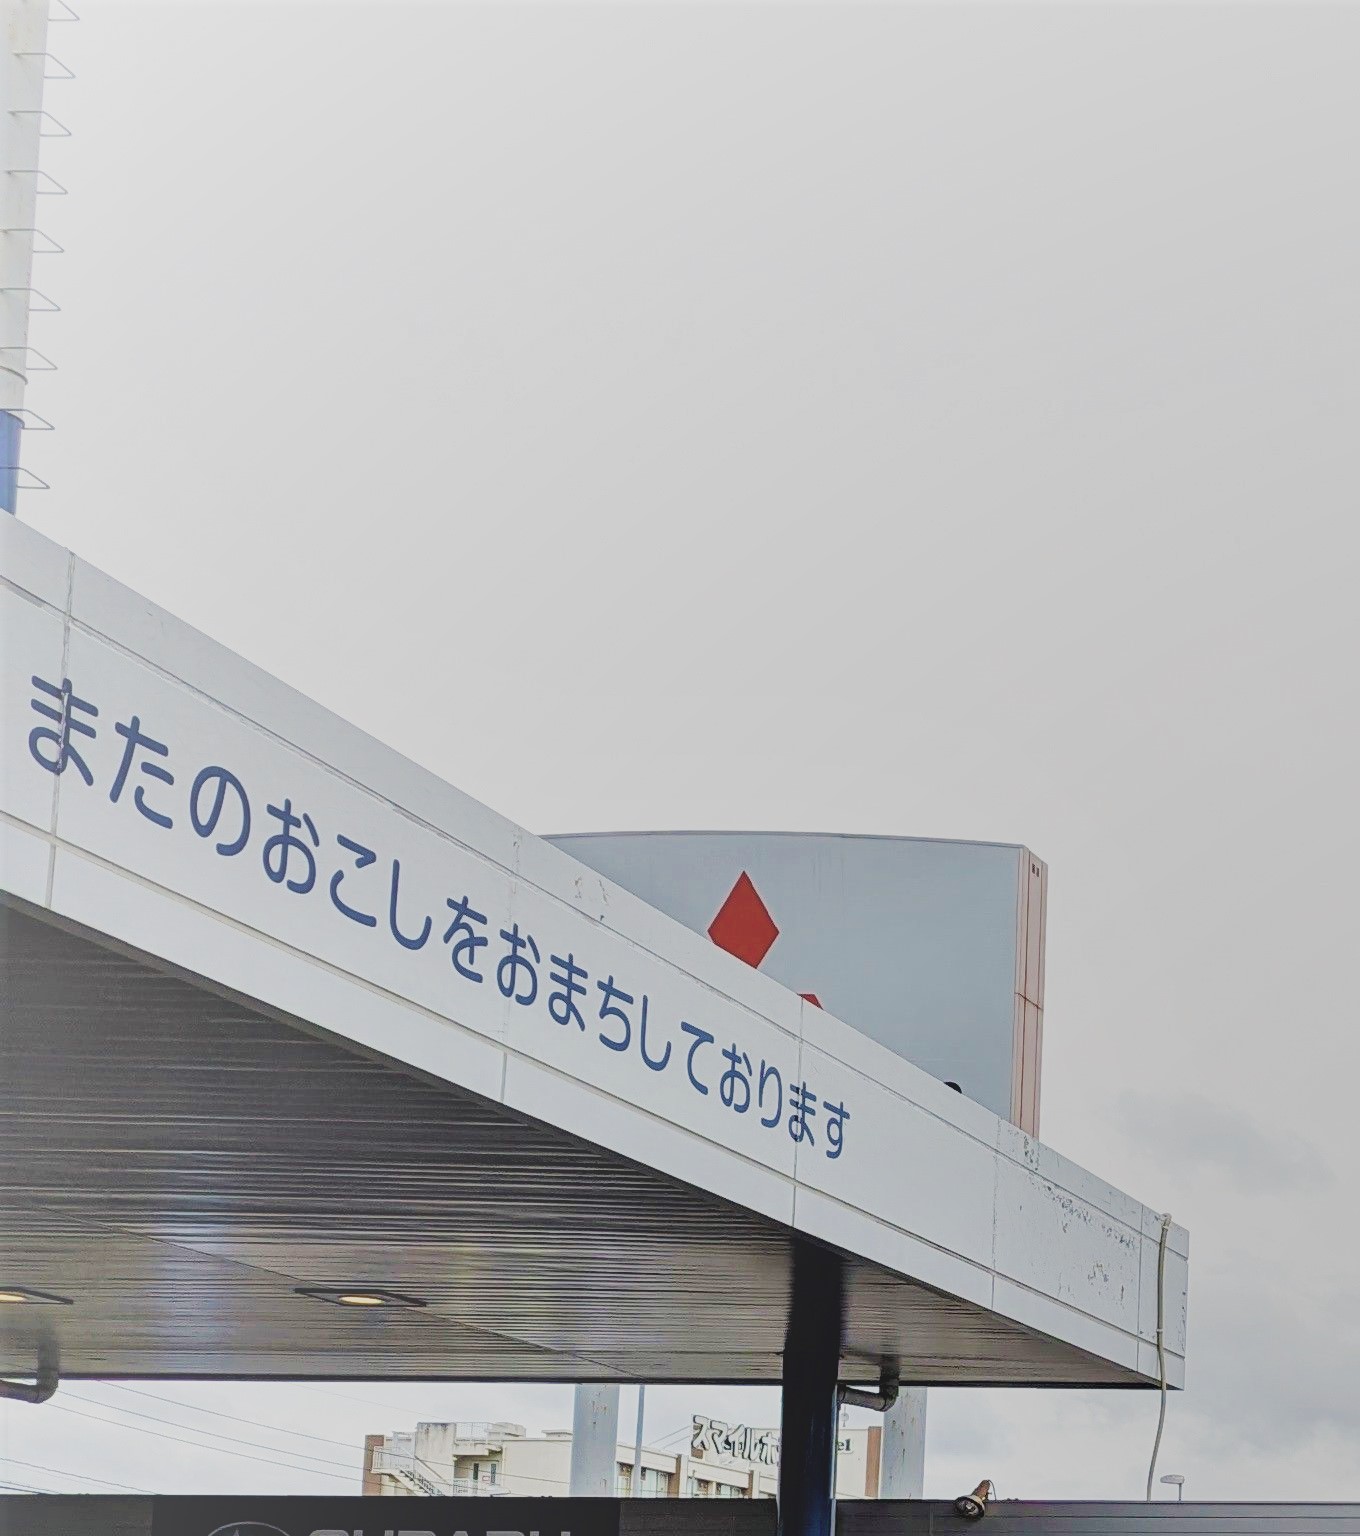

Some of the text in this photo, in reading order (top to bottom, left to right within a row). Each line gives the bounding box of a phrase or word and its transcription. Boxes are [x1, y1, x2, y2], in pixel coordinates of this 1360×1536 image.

[28, 675, 850, 1160] またのおこしをおまちしております
